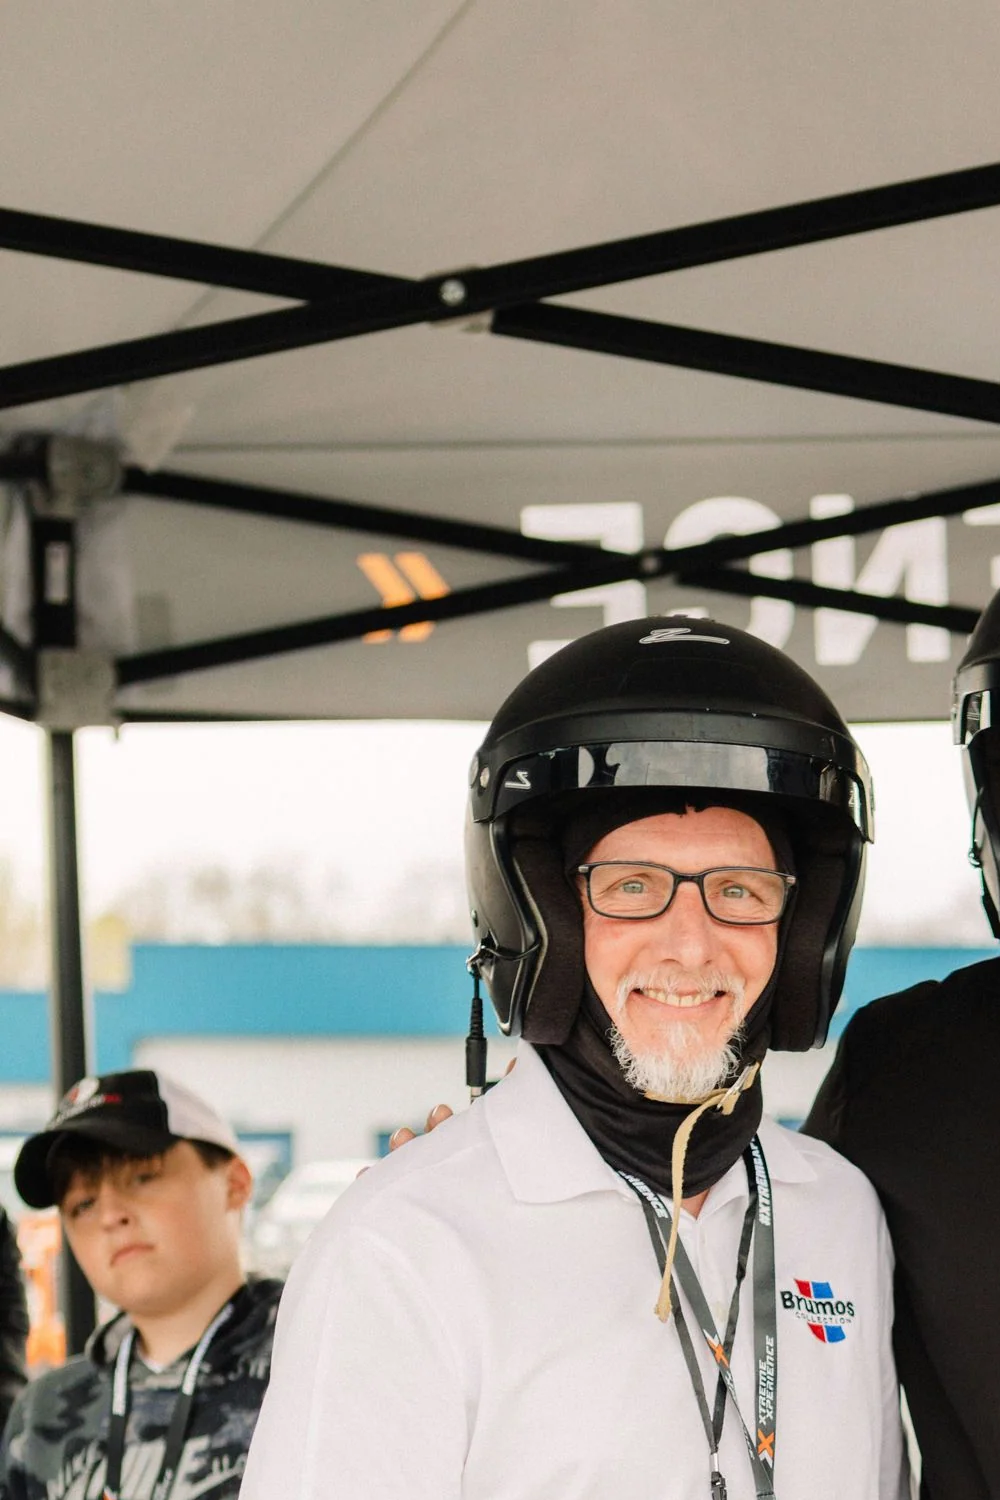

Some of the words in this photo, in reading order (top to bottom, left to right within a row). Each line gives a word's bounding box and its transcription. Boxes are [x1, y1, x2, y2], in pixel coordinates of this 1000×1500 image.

[780, 1291, 855, 1317] Brumos
[758, 1360, 767, 1425] XTREME
[765, 1336, 774, 1420] XPERIENCE
